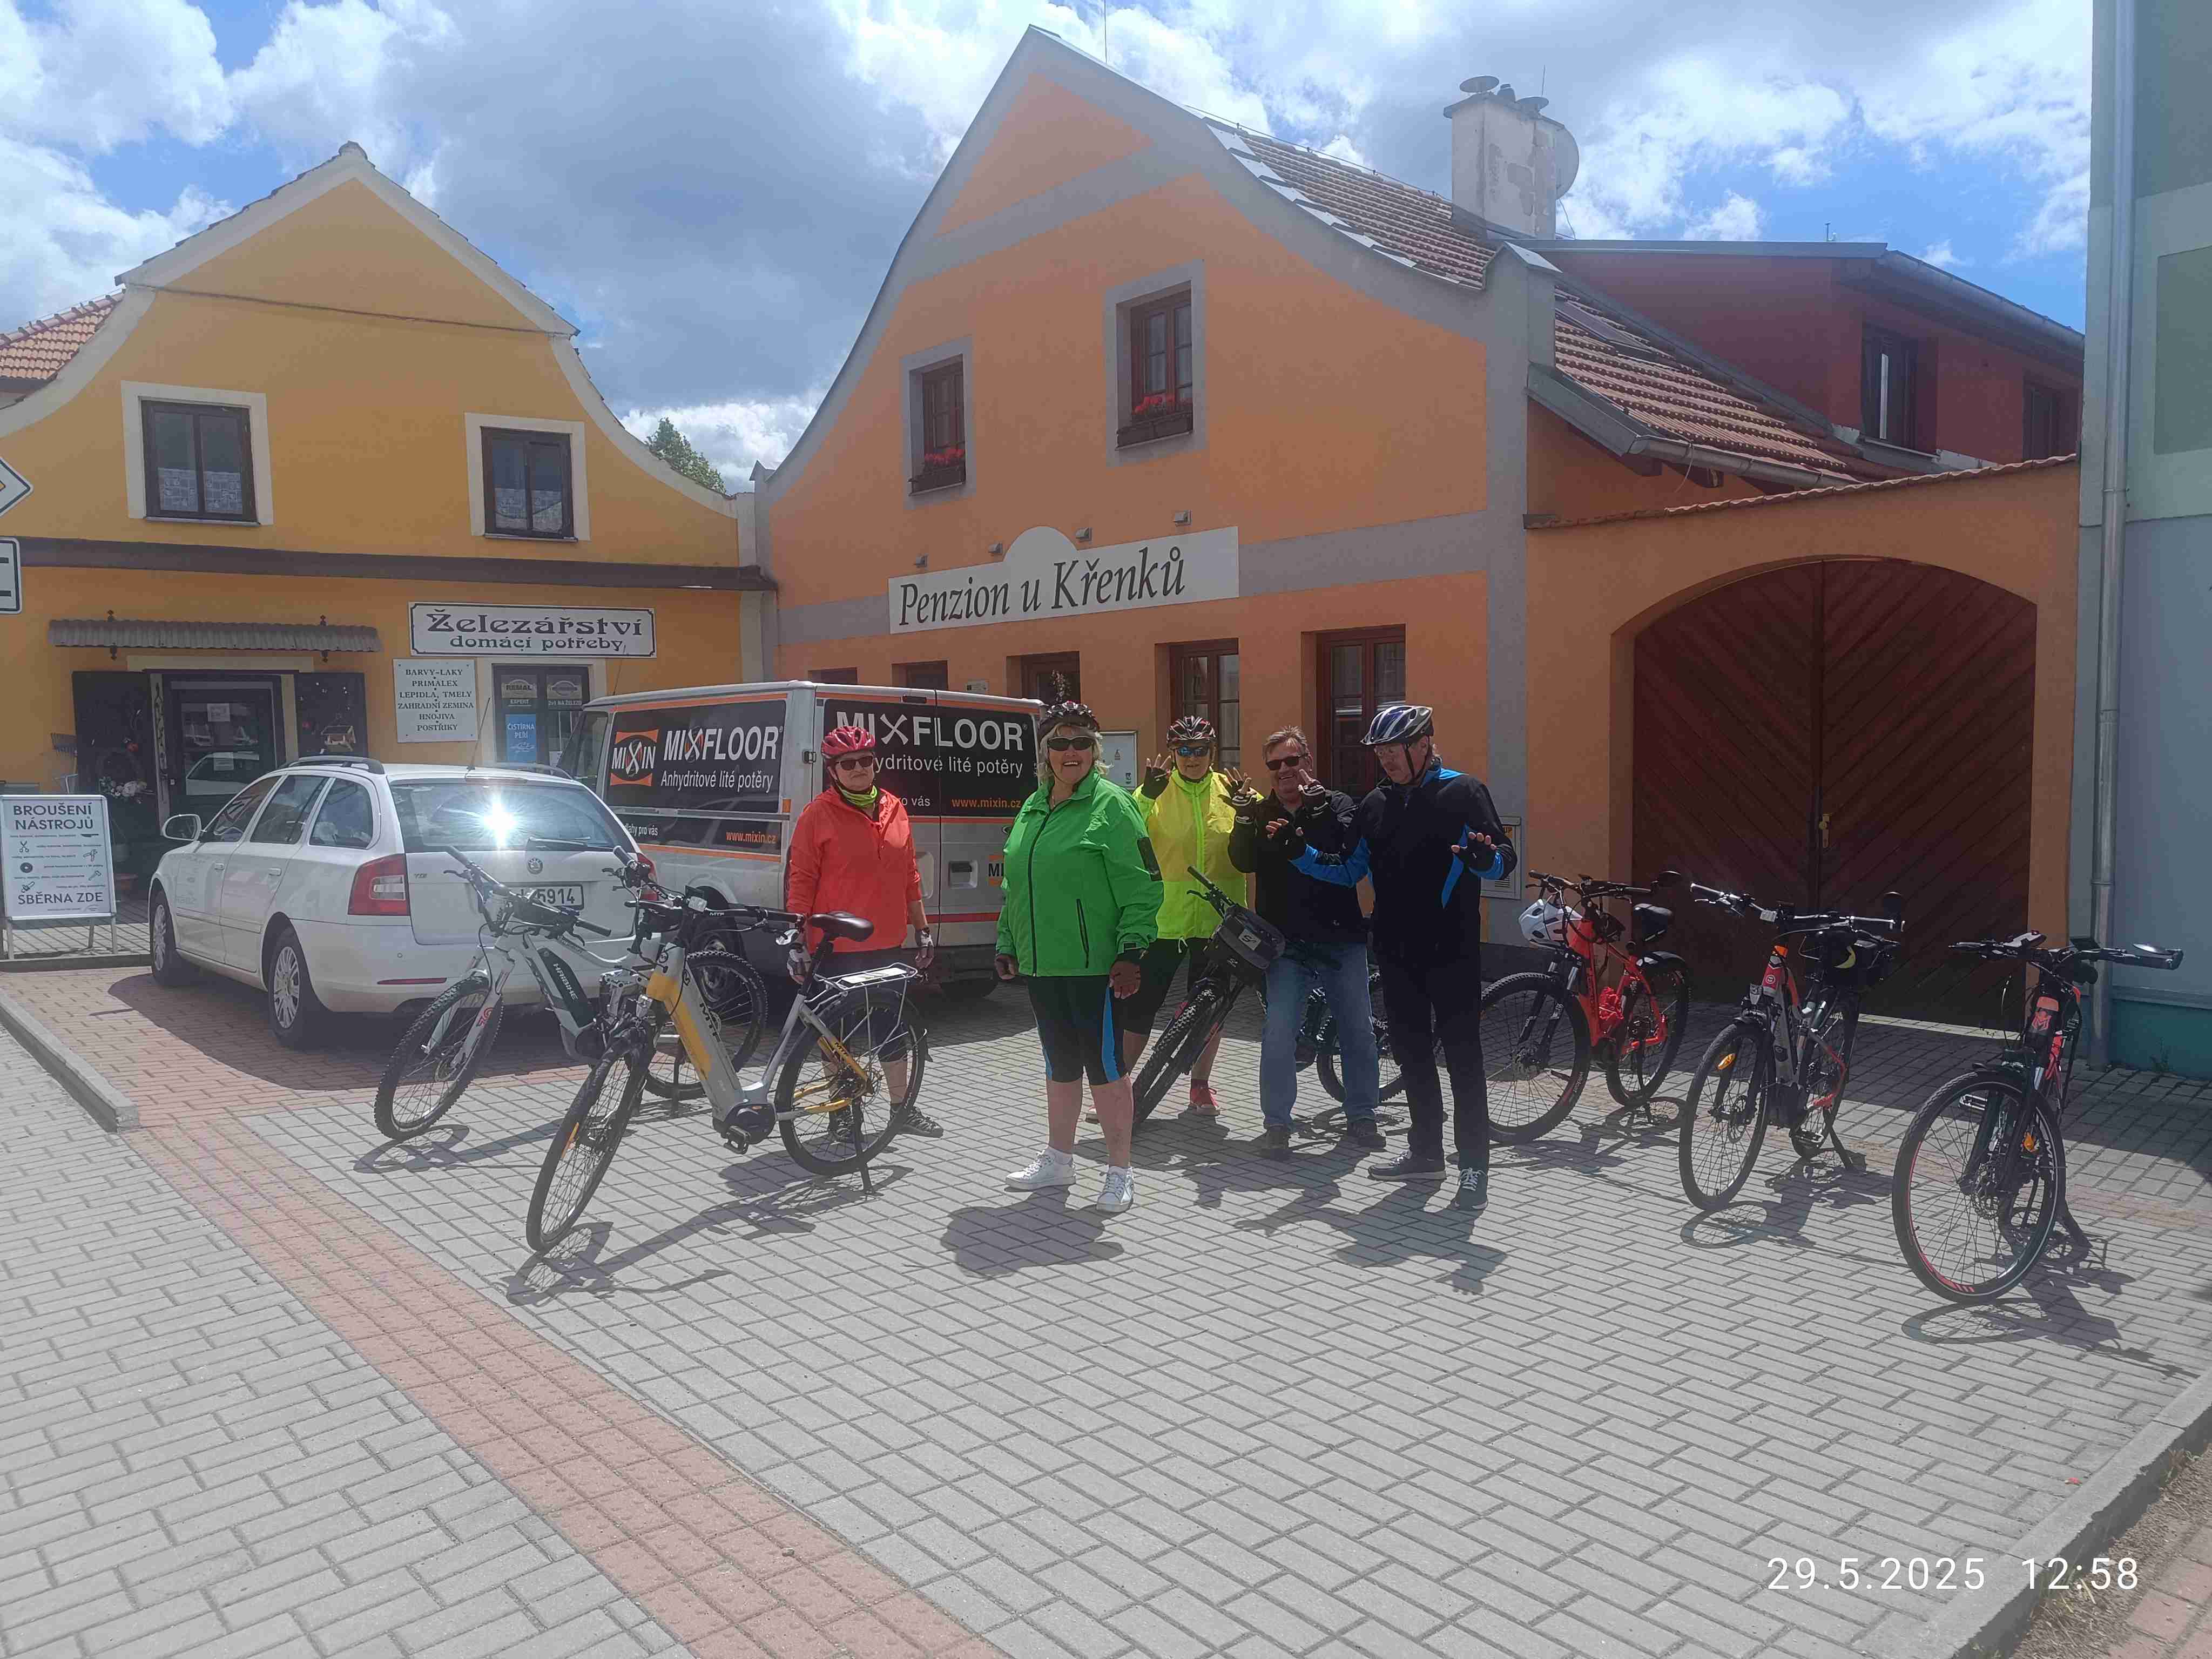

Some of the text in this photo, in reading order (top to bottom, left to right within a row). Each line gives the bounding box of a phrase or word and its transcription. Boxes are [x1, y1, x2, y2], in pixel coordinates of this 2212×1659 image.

[899, 546, 1185, 626] Penzion u Křenků
[426, 608, 642, 636] Železářství
[449, 635, 625, 652] domácí potřeby
[416, 723, 458, 731] POSTŘIKY
[507, 721, 535, 730] ČISTÍRNA
[611, 741, 656, 774] MIXIN
[875, 754, 943, 773] ydritové
[949, 756, 972, 773] lité
[977, 759, 1023, 778] potěry
[660, 770, 773, 793] Anhydritové lité potěry
[911, 795, 930, 806] vás
[952, 797, 1021, 808] www.mixin.cz
[13, 802, 92, 816] BROUŠENÍ
[15, 816, 94, 830] NÁSTROJŮ
[648, 825, 658, 836] vás
[726, 831, 777, 844] www.mixin.cz
[18, 892, 104, 905] SBĚRNA ZDE
